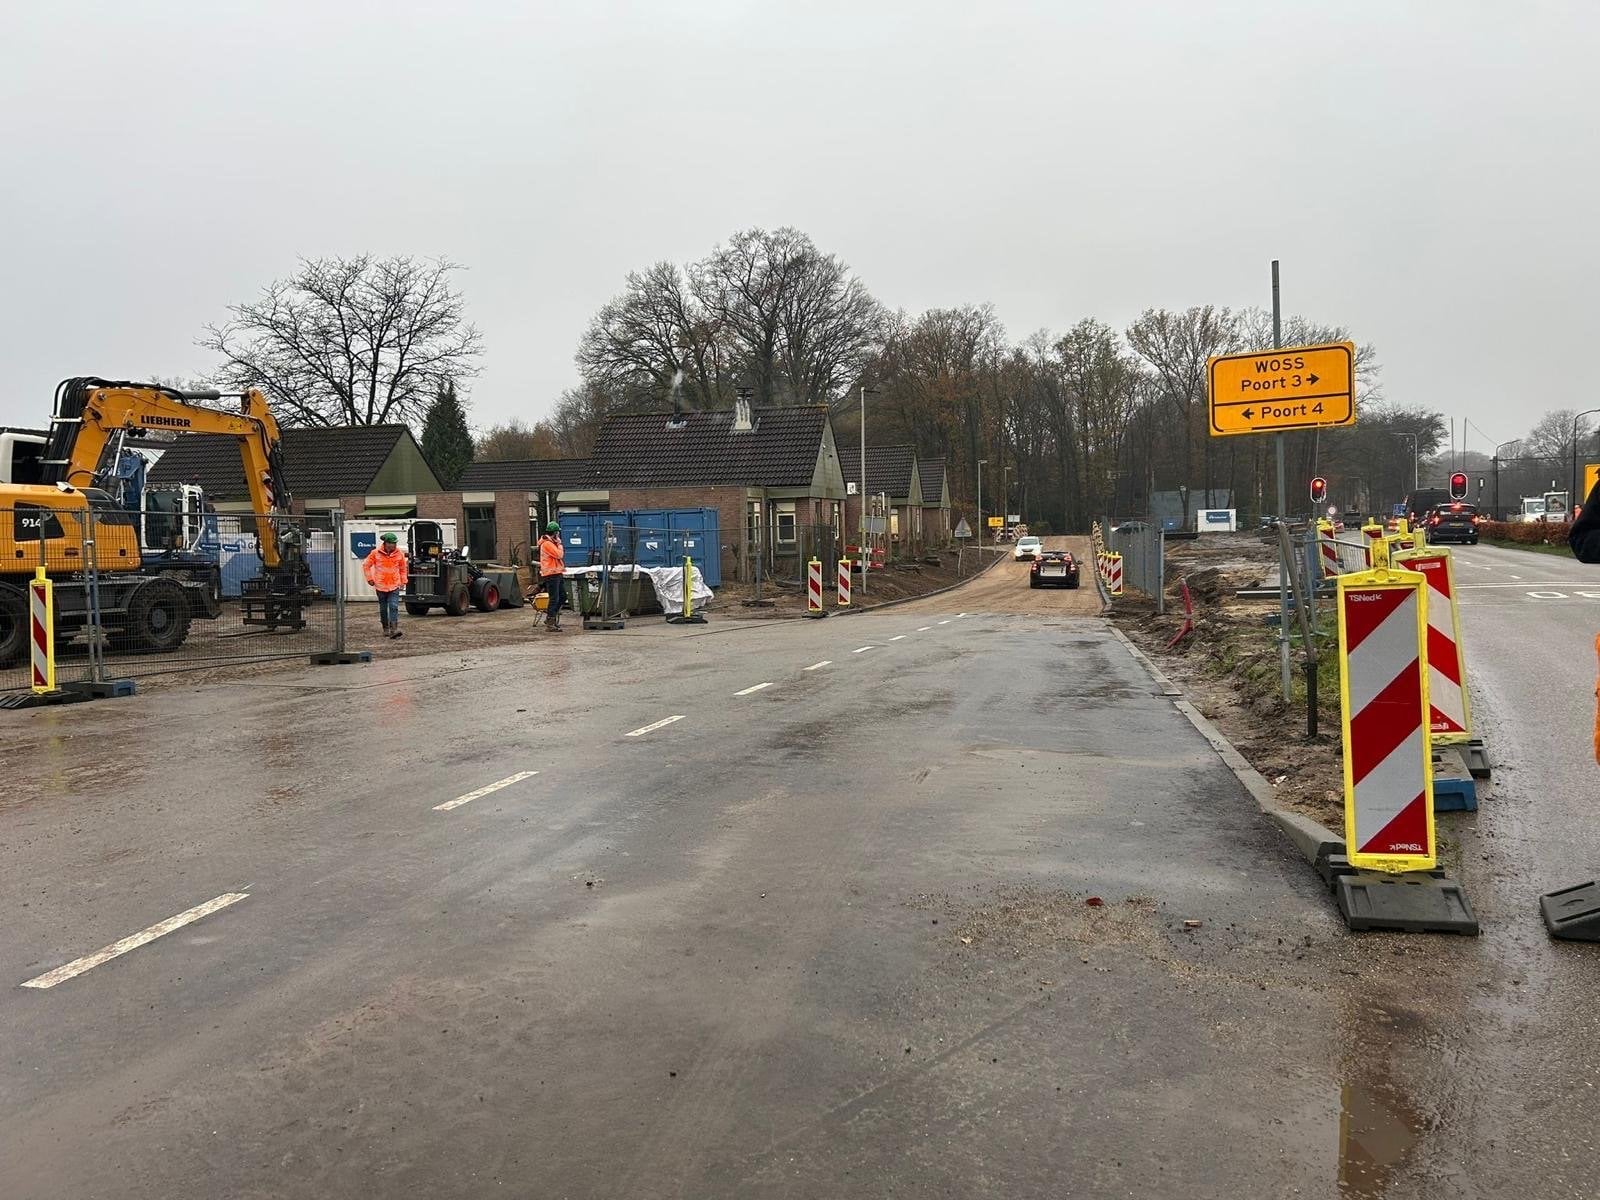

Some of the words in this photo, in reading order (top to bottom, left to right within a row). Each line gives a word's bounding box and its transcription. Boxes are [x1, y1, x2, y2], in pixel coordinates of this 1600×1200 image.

[1255, 357, 1305, 373] WOSS
[1241, 376, 1287, 392] Poort
[1291, 375, 1302, 387] 3
[1261, 404, 1307, 419] Poort
[1311, 402, 1324, 415] 4
[140, 415, 191, 428] LIEBHERR
